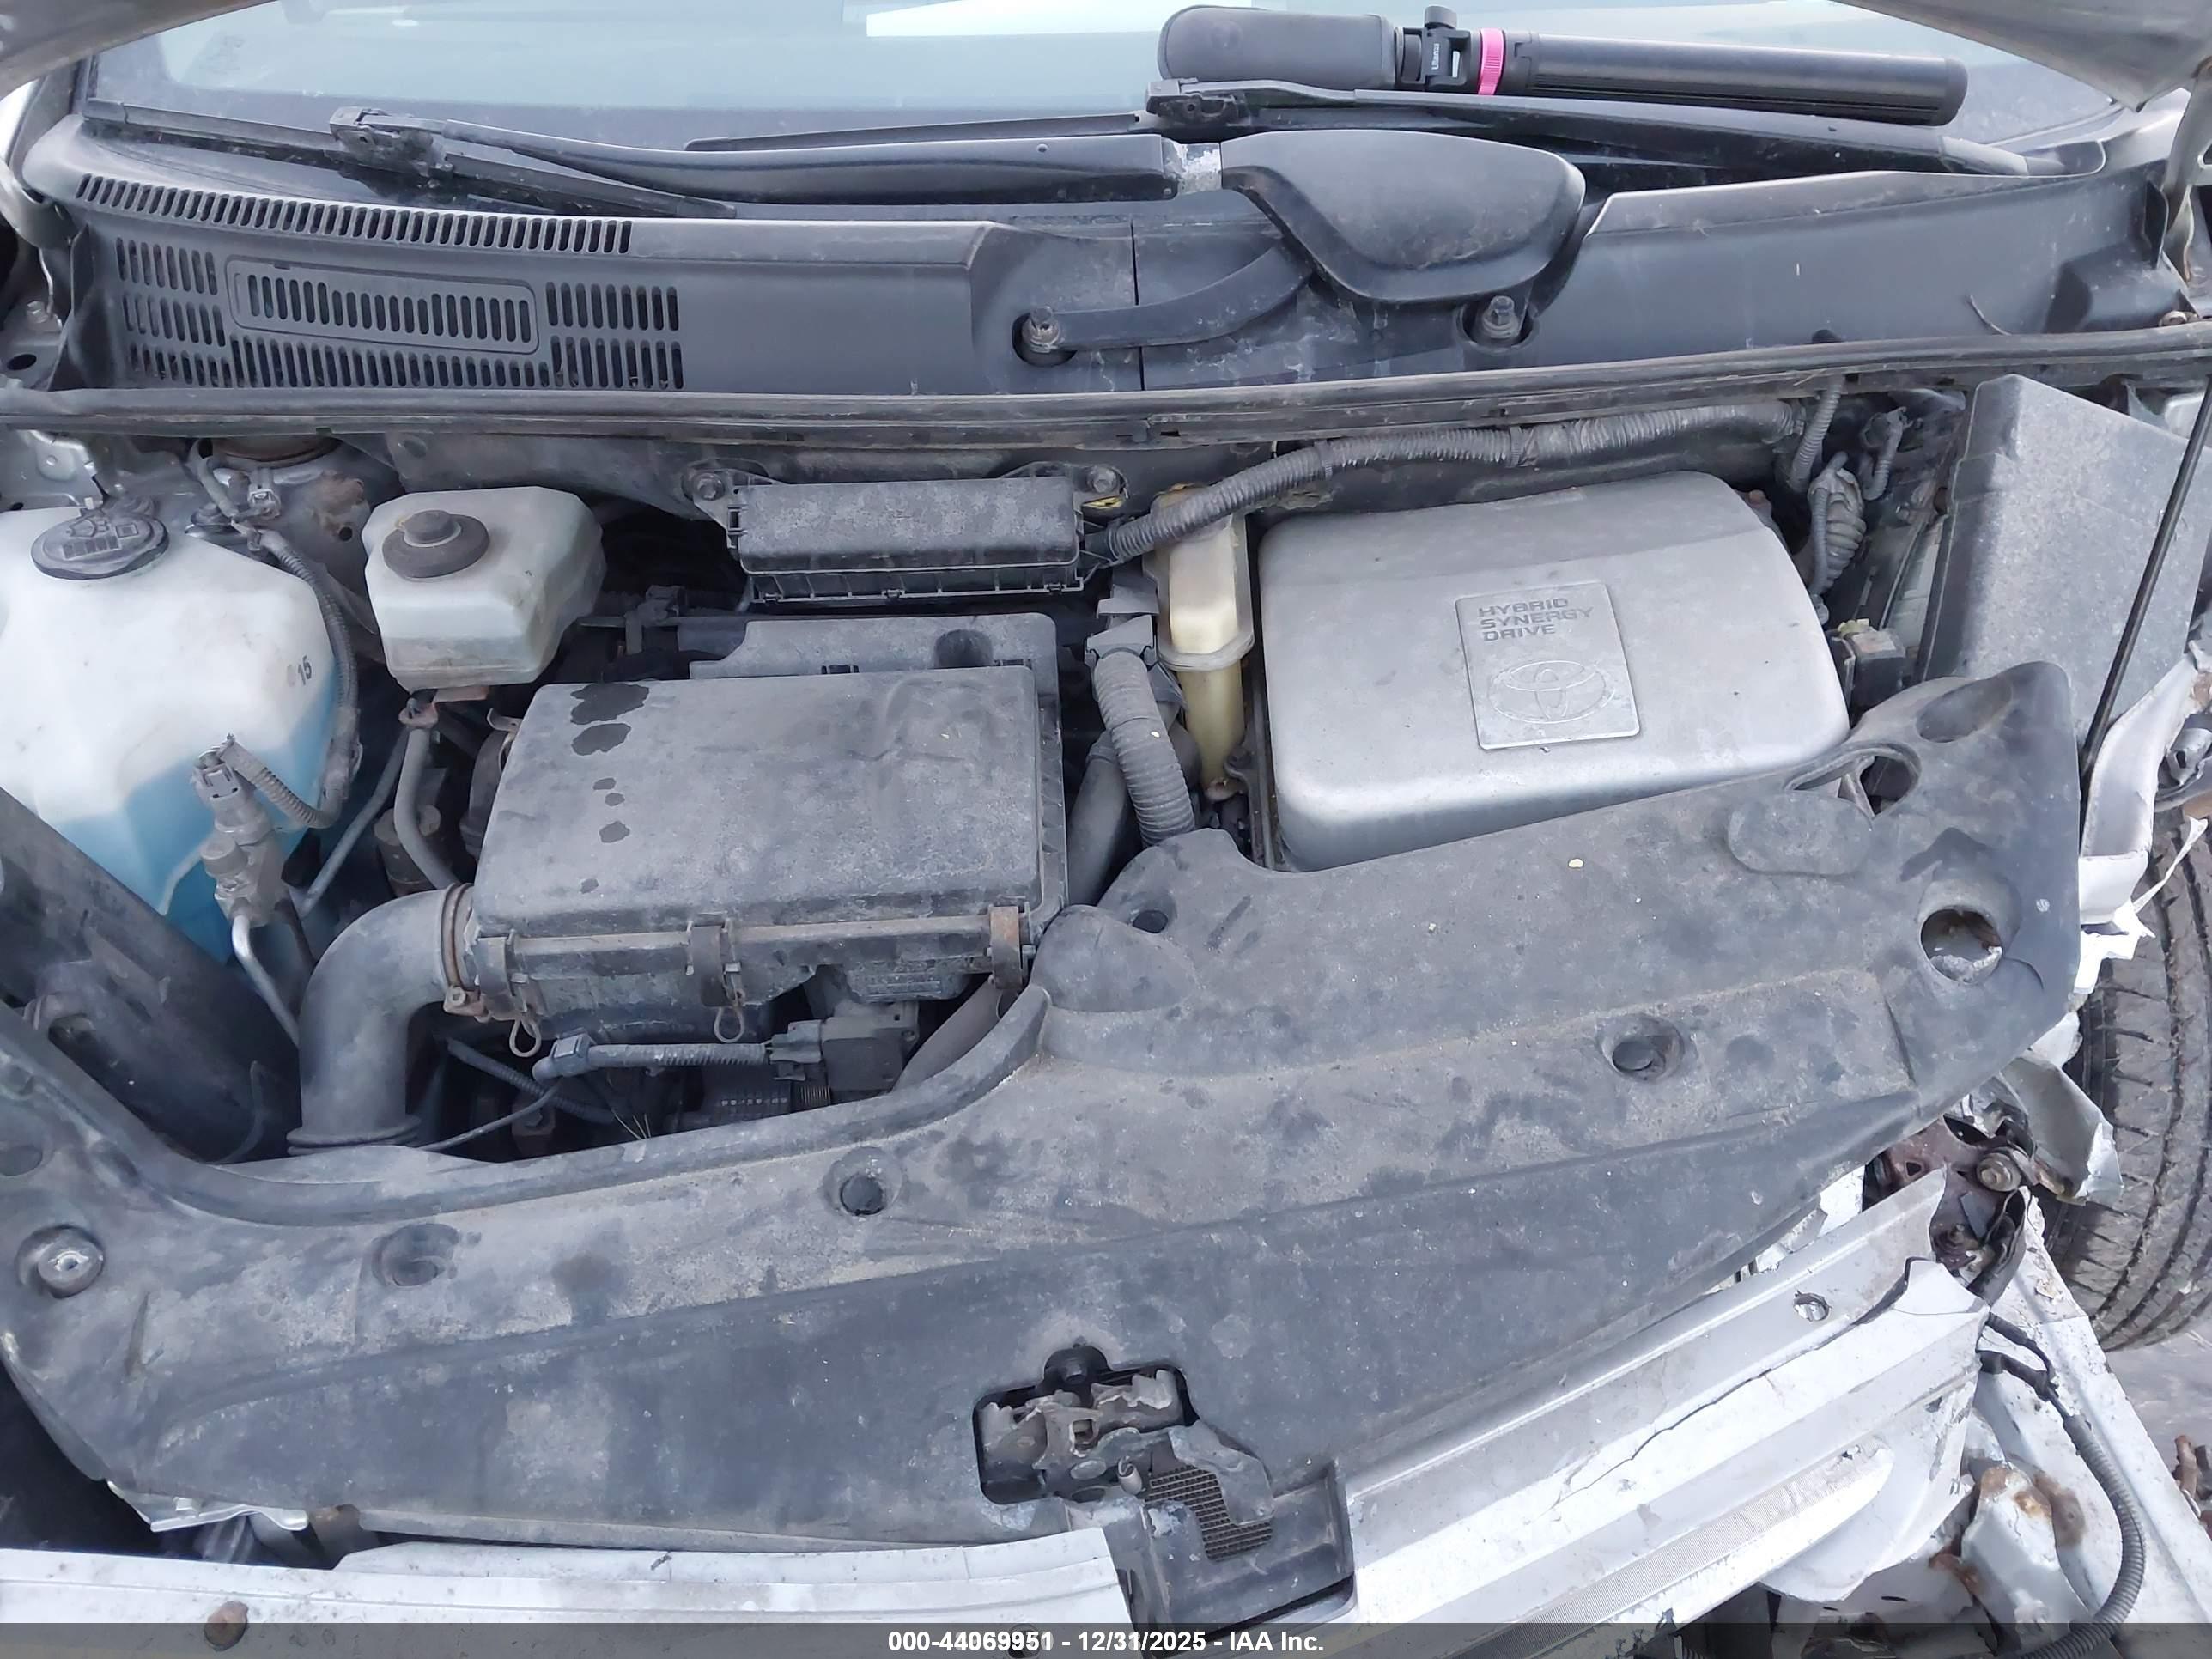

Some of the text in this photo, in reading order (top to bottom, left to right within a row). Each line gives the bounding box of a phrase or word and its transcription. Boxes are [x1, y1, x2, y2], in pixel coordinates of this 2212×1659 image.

[1478, 598, 1569, 617] HYBRID
[1480, 606, 1594, 629] SYNERGY
[1482, 624, 1556, 641] DRIVE
